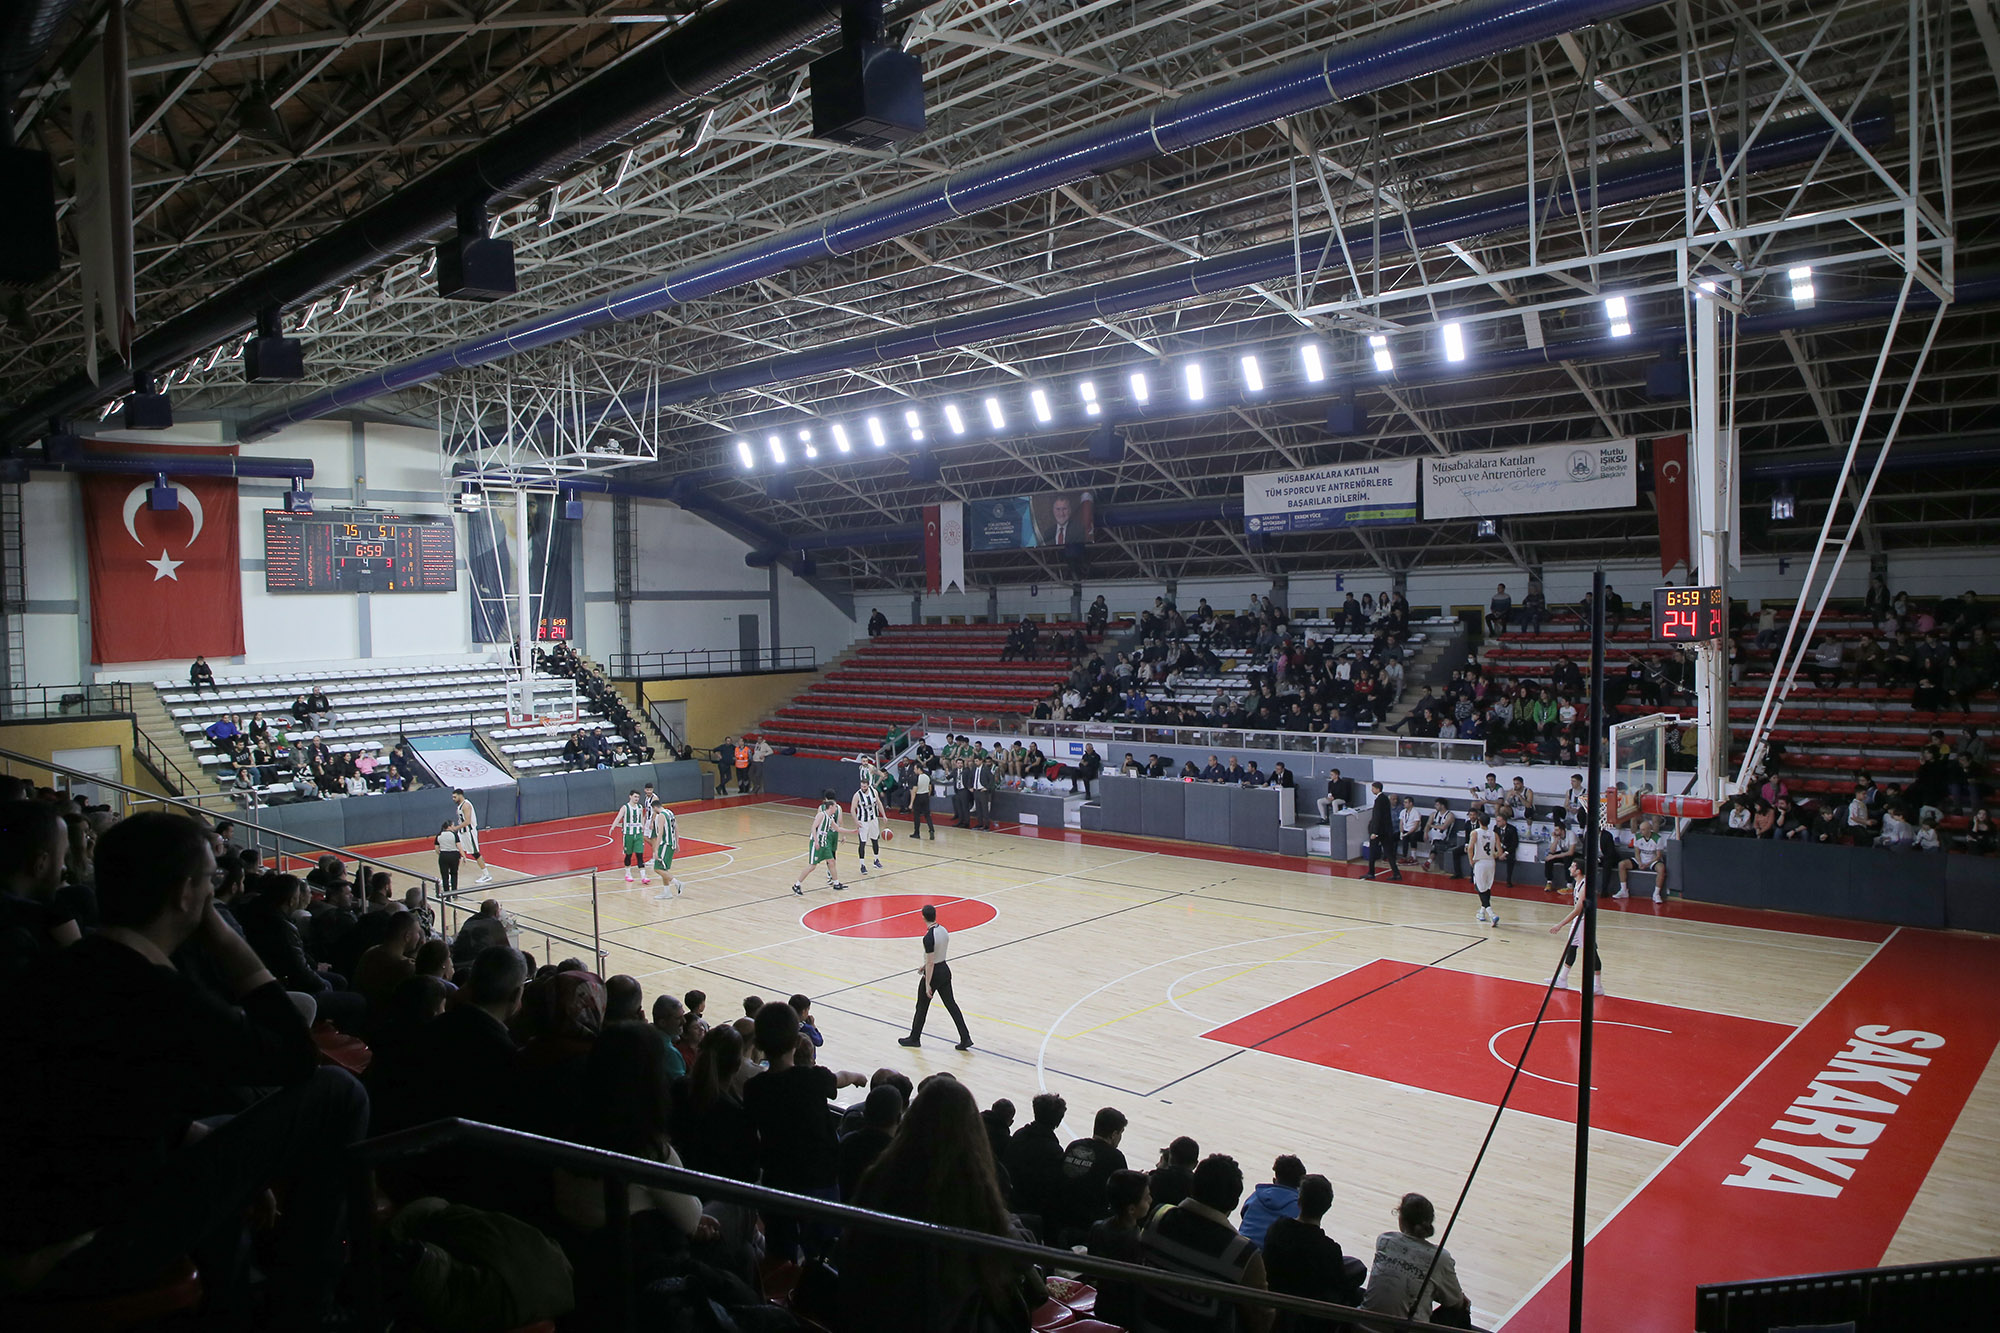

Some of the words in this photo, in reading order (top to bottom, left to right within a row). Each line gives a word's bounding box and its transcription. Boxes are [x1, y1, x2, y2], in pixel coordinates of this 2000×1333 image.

[1600, 448, 1624, 457] Mutlu
[1432, 459, 1498, 472] Müsabakalara
[1500, 455, 1536, 467] Katılan
[1600, 464, 1628, 473] Belediye
[1277, 471, 1342, 484] MÜSABAKALARA
[1344, 466, 1380, 477] KATILAN
[1433, 474, 1467, 487] Sporcu
[1468, 473, 1480, 481] ve
[1481, 467, 1546, 481] Antrenörlere
[1265, 488, 1282, 497] TÜM
[1283, 485, 1315, 496] SPORCU
[1316, 484, 1327, 492] VE
[1328, 477, 1393, 491] ANTRENÖRLERE
[1287, 496, 1332, 508] BAŞARILAR
[1334, 492, 1370, 504] DİLERİM.
[343, 523, 359, 537] 75
[378, 524, 395, 538] 51
[355, 544, 383, 558] 6:59
[340, 557, 346, 568] 1
[362, 558, 369, 568] 4
[385, 557, 393, 569] 3
[1779, 557, 1792, 575] F
[1335, 573, 1345, 592] E
[1667, 591, 1700, 606] 6:59
[1663, 610, 1697, 637] 24
[1709, 608, 1721, 636] 24
[550, 626, 566, 639] 24
[1483, 841, 1491, 856] 4
[1721, 1024, 1946, 1199] SAKARYA
